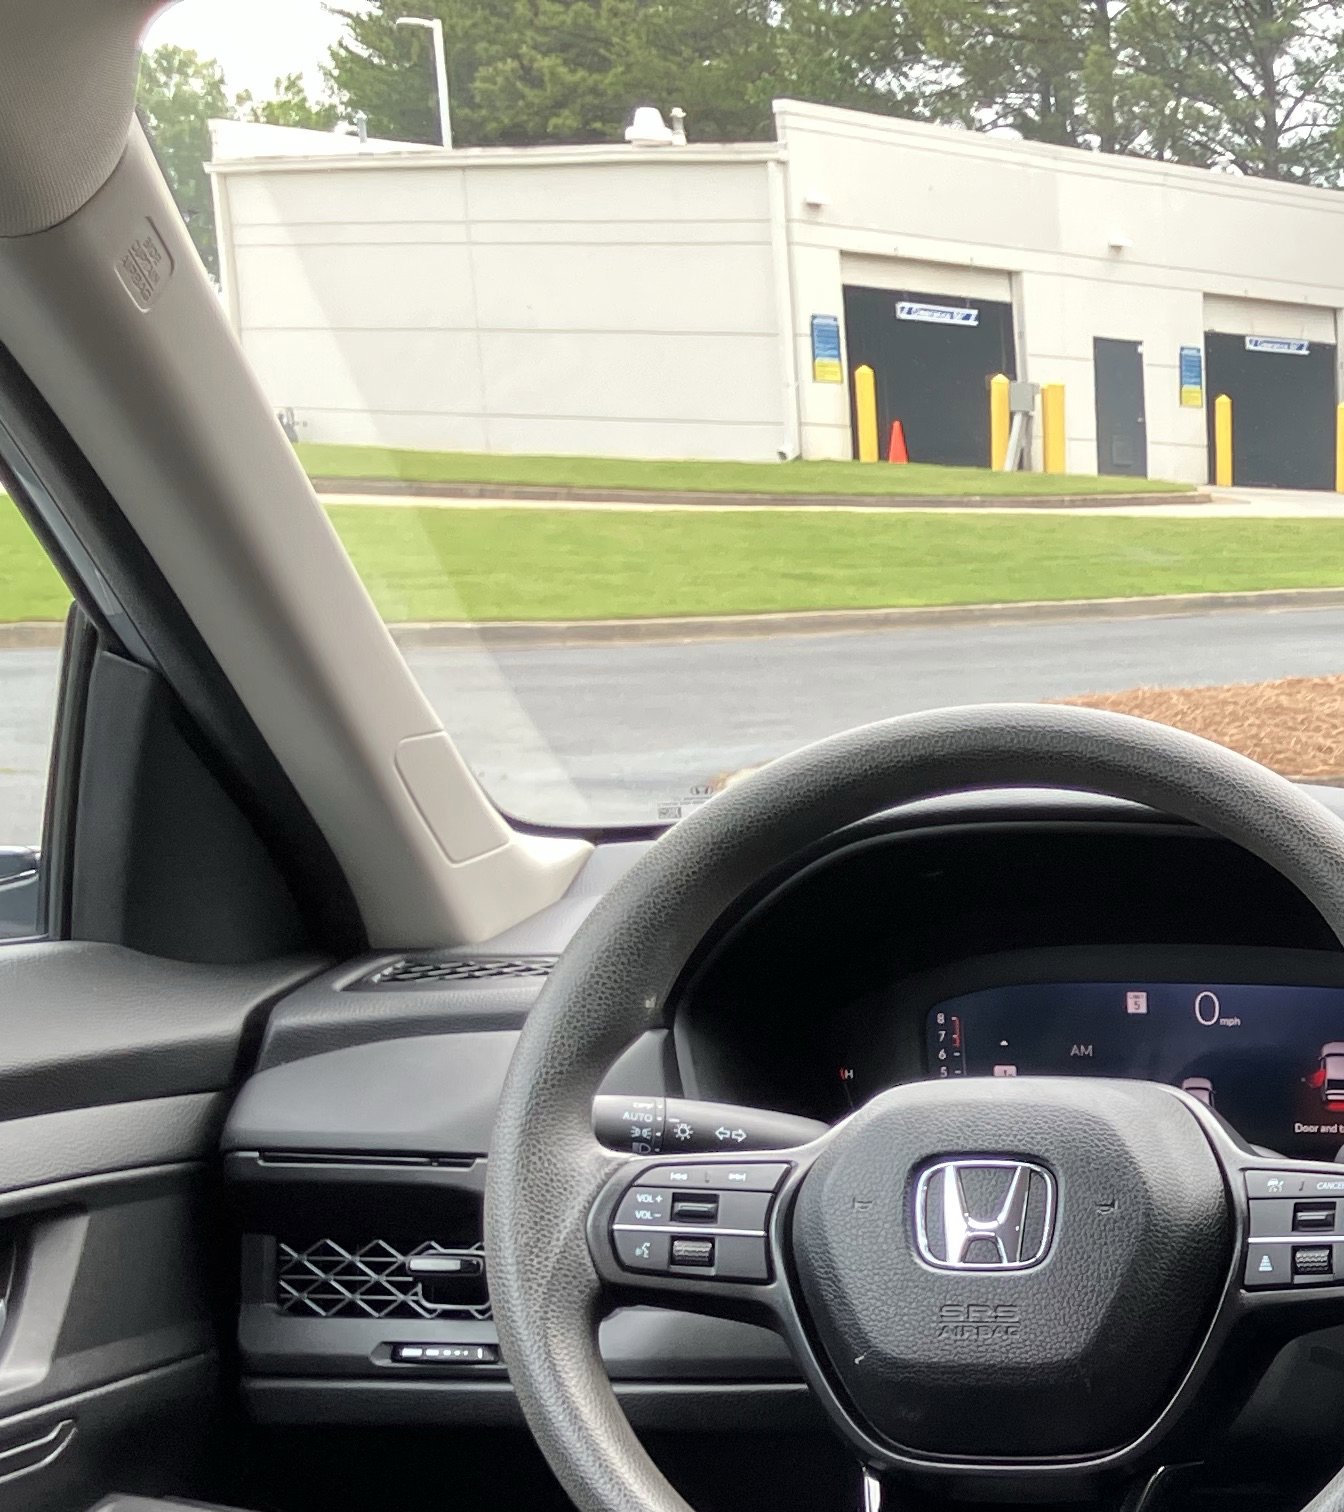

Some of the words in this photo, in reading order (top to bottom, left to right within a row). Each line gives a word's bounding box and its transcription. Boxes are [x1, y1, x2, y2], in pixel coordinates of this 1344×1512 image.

[1133, 1001, 1141, 1010] 5
[1195, 991, 1219, 1026] 0
[1219, 1017, 1241, 1027] mph
[936, 1012, 945, 1024] 8
[938, 1030, 946, 1042] 7
[938, 1049, 947, 1060] 6
[1070, 1044, 1093, 1057] AM
[940, 1066, 948, 1078] 5
[622, 1111, 653, 1122] AUTO
[1294, 1123, 1318, 1133] Door
[1320, 1123, 1338, 1133] and
[636, 1194, 653, 1203] VOL
[635, 1211, 653, 1220] VOL
[939, 1304, 1020, 1321] SRS
[937, 1325, 1021, 1340] AIRBAG
